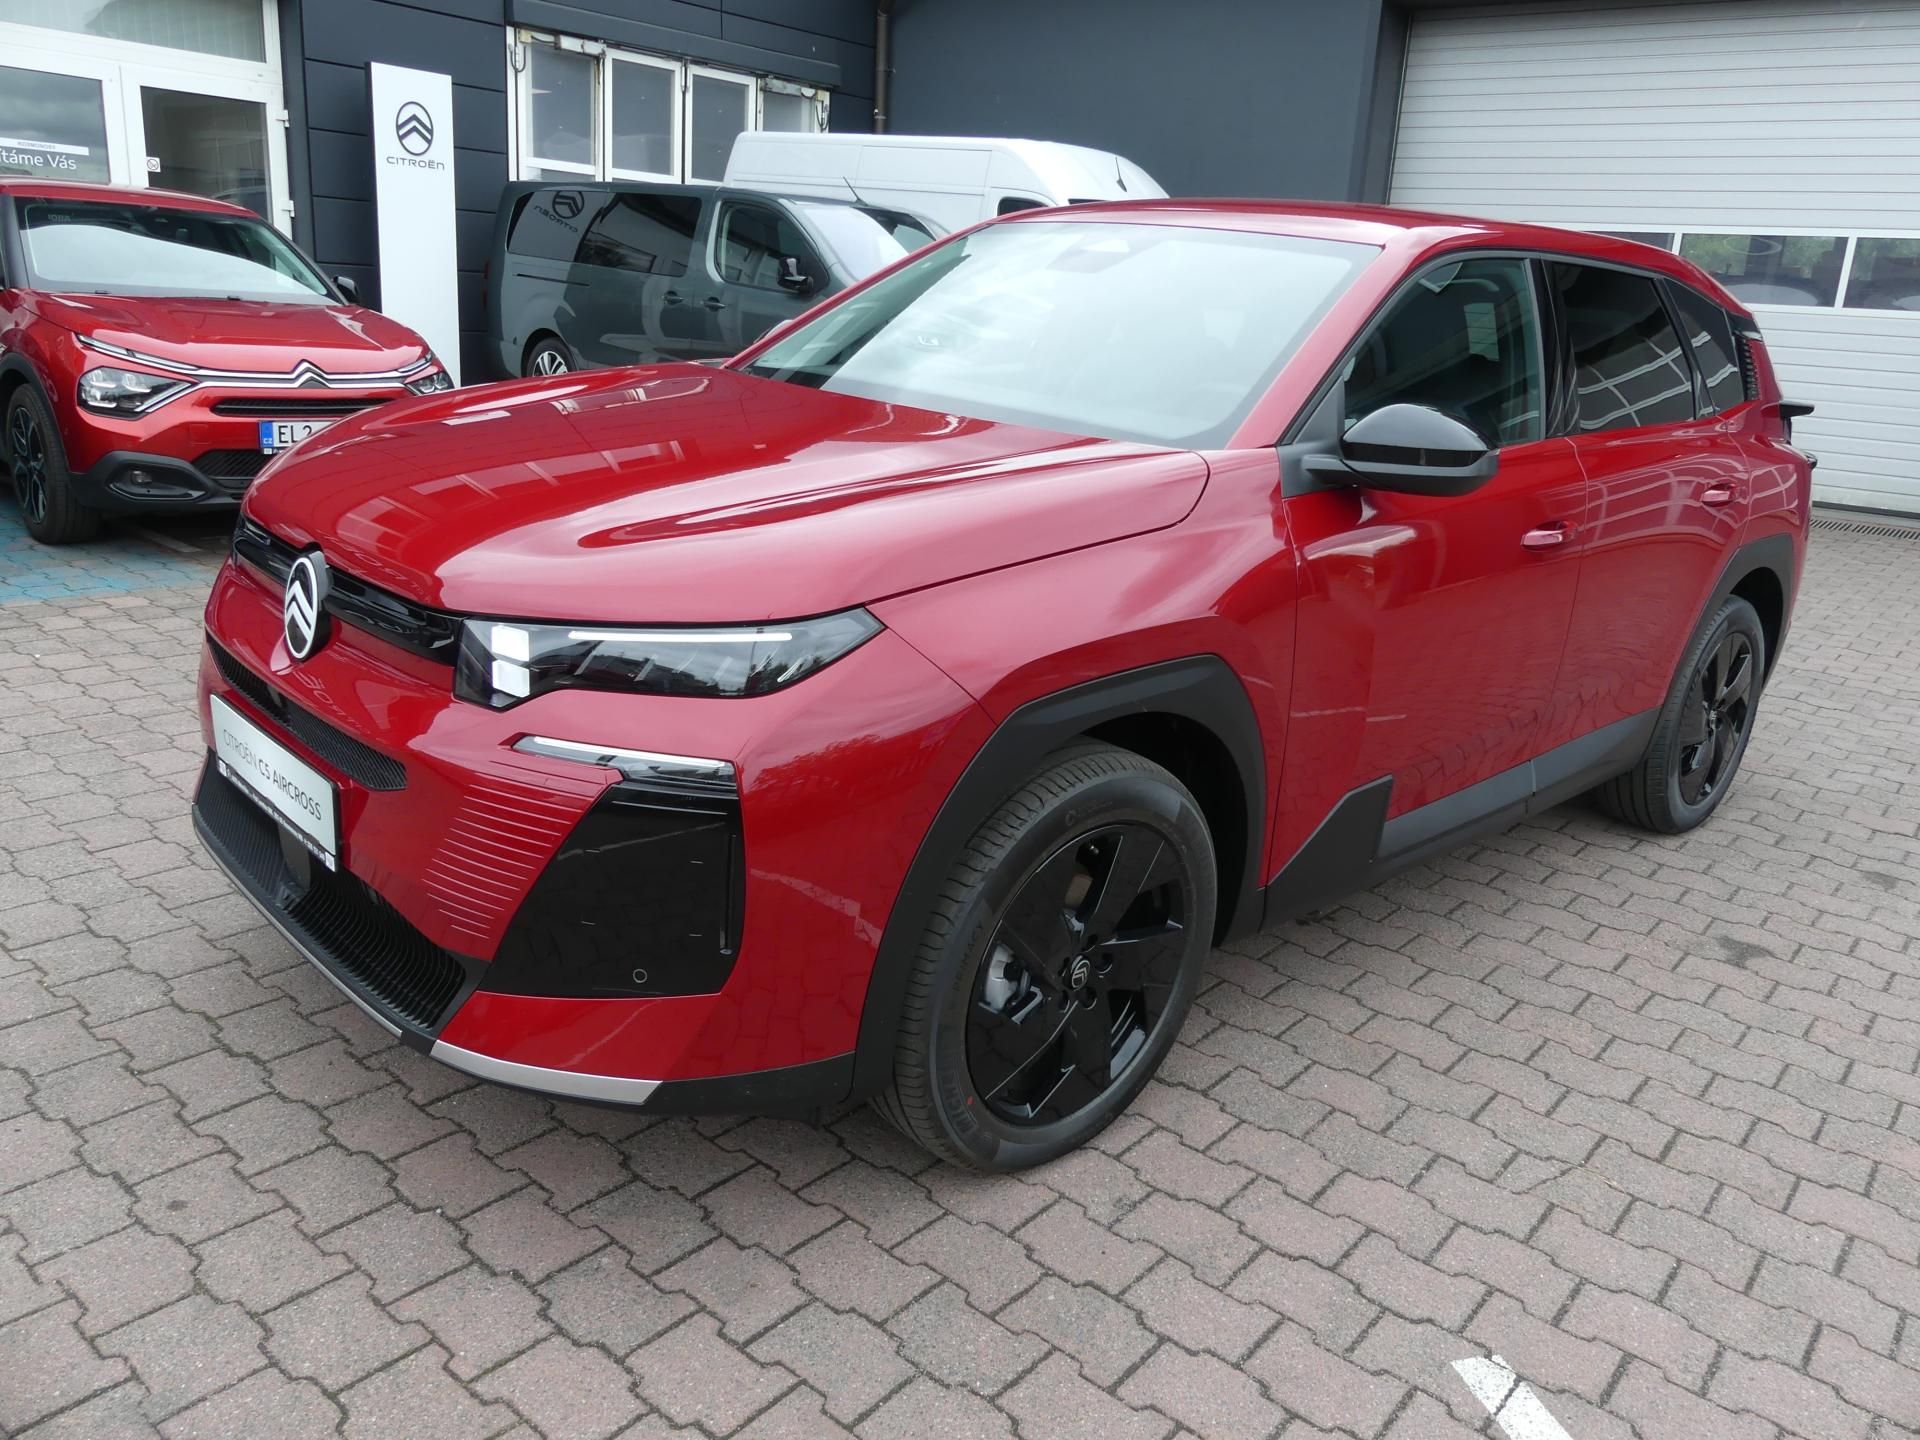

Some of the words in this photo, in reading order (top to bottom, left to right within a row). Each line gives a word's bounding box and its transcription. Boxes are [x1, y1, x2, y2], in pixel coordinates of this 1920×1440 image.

[46, 154, 78, 170] Vás
[223, 728, 257, 768] CITROËN
[259, 757, 271, 781] C5
[272, 768, 322, 821] AIRCROSS
